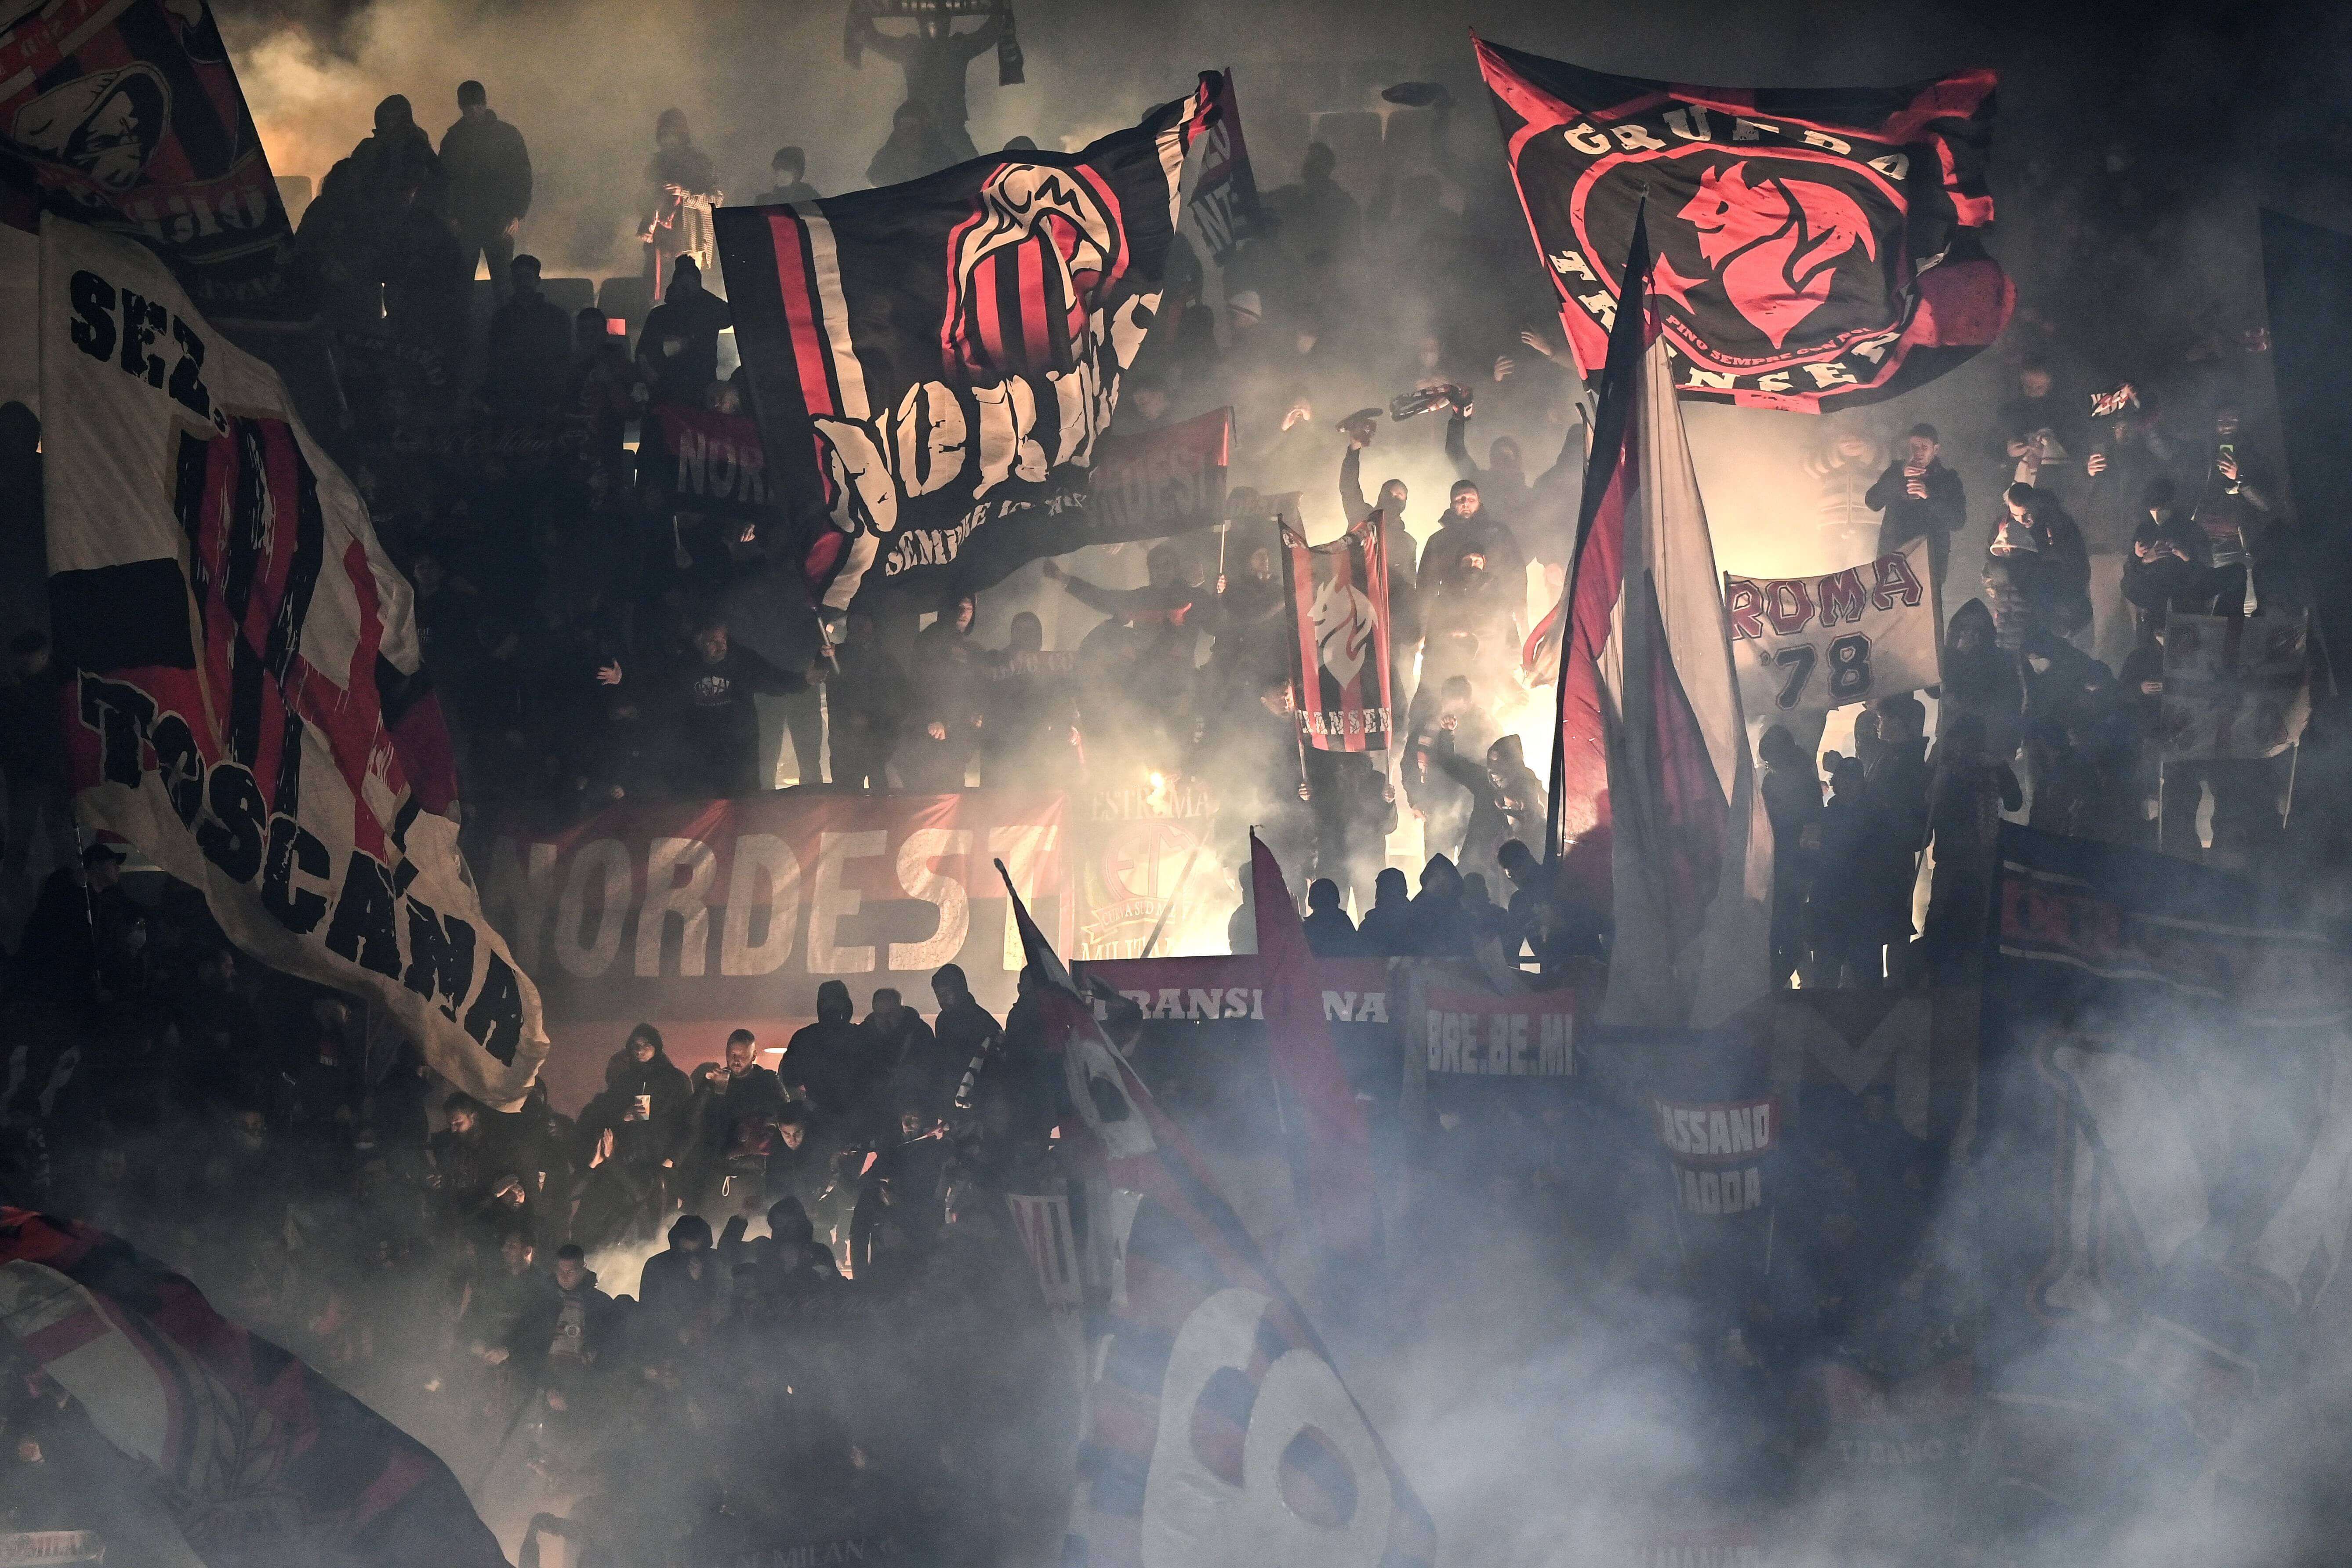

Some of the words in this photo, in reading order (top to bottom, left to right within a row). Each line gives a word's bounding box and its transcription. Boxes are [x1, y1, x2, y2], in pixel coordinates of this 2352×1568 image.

[974, 164, 1086, 254] ACM
[1666, 315, 1709, 350] PINO
[1725, 552, 1923, 641] ROMA
[1092, 785, 1212, 821] ESTRMA
[78, 668, 524, 1067] TOSCANA
[1135, 901, 1154, 916] SUD
[1655, 1099, 1770, 1154] ASSANO
